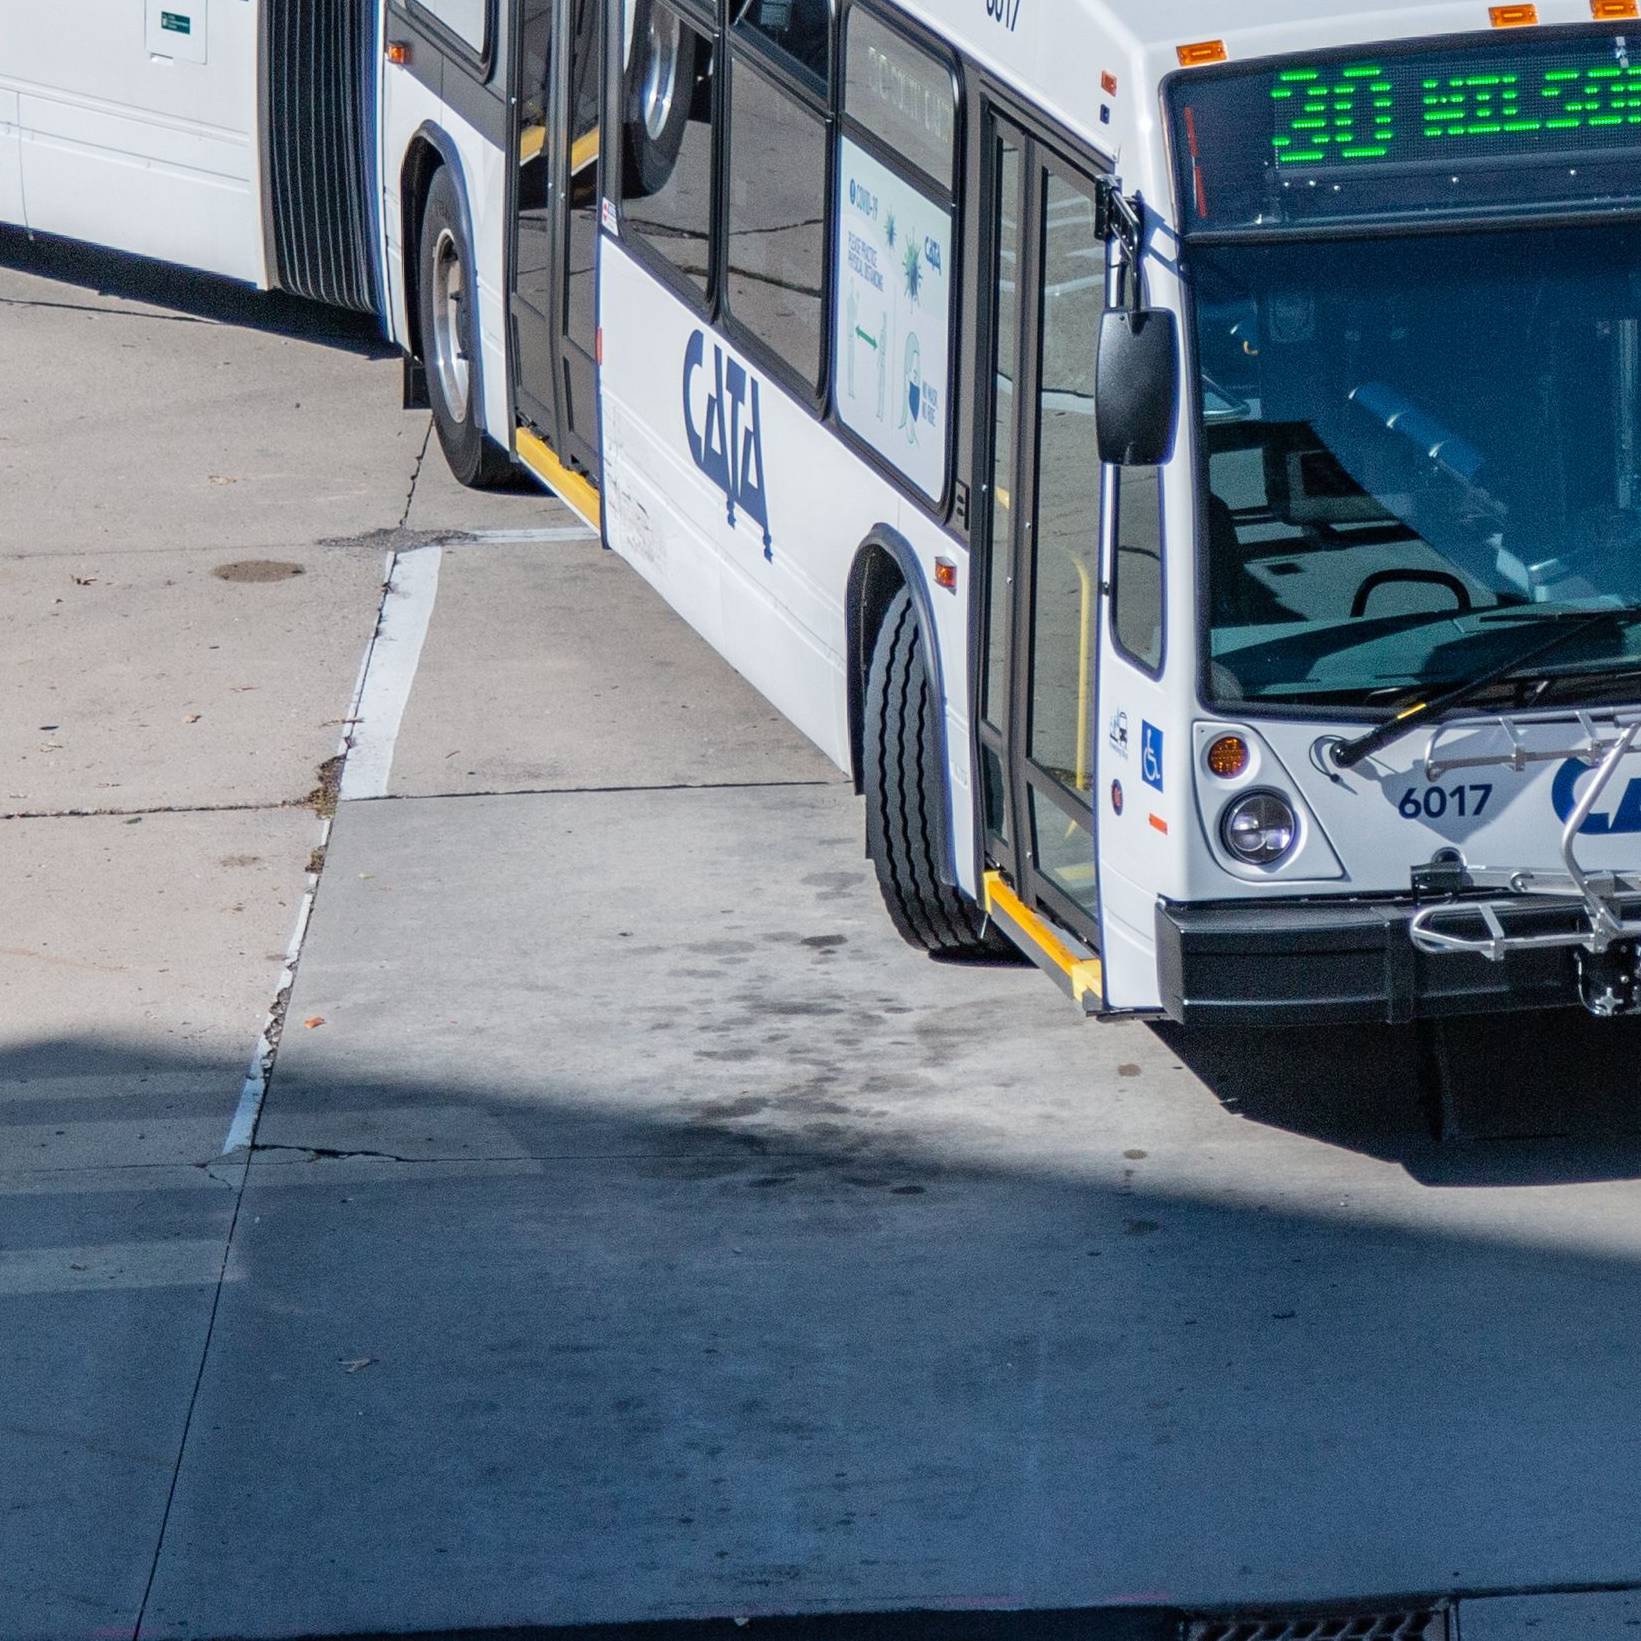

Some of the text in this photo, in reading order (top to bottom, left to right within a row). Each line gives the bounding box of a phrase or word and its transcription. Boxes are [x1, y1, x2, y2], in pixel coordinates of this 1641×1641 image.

[924, 236, 942, 277] CATA
[683, 329, 773, 565] CATA
[1398, 784, 1493, 820] 6017
